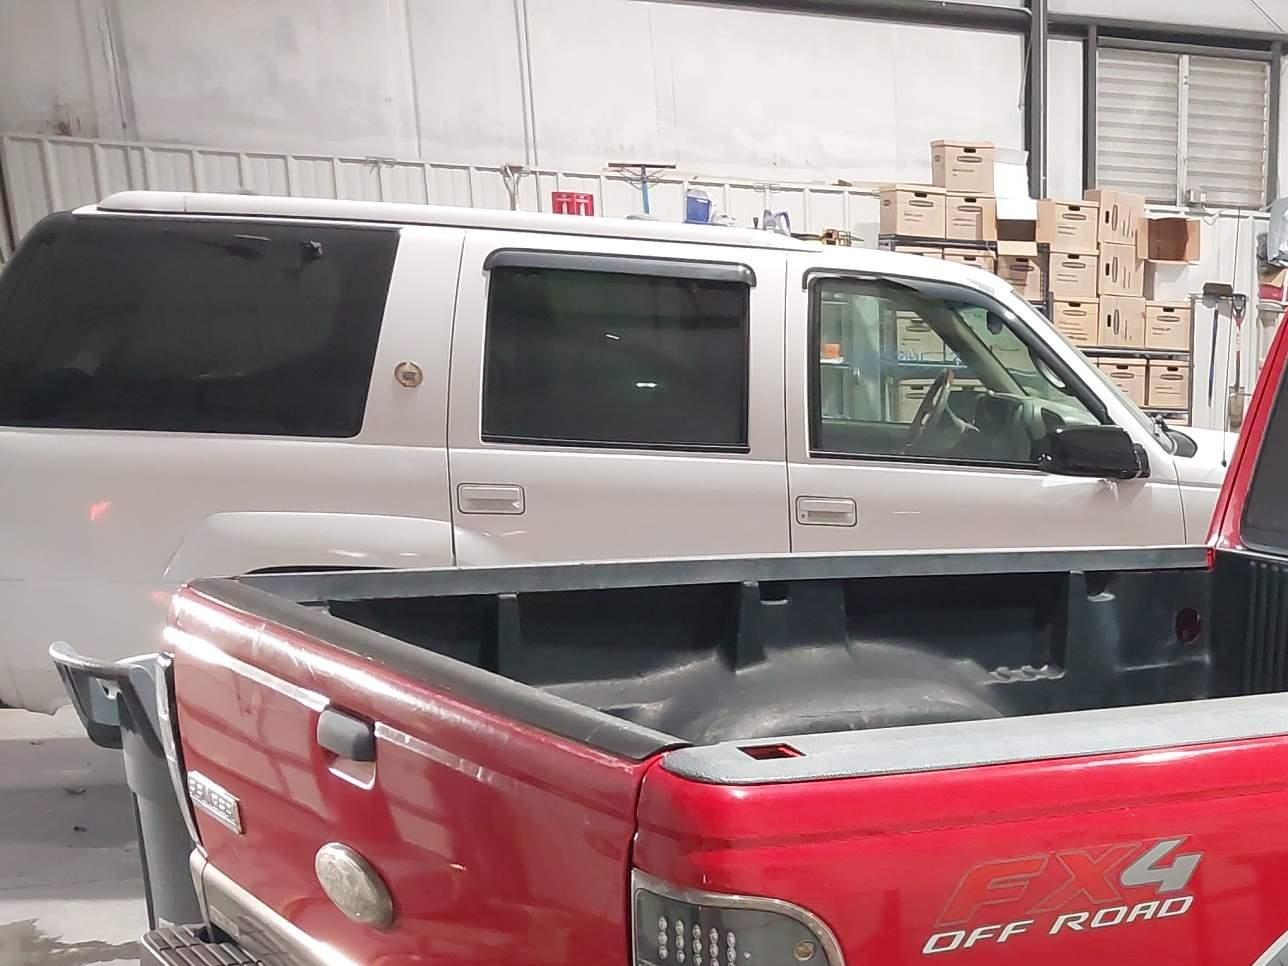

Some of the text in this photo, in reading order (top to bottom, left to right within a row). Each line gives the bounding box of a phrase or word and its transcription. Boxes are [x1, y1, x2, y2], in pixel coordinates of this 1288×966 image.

[933, 834, 1204, 928] FX4
[921, 895, 1195, 955] OFF ROAD
